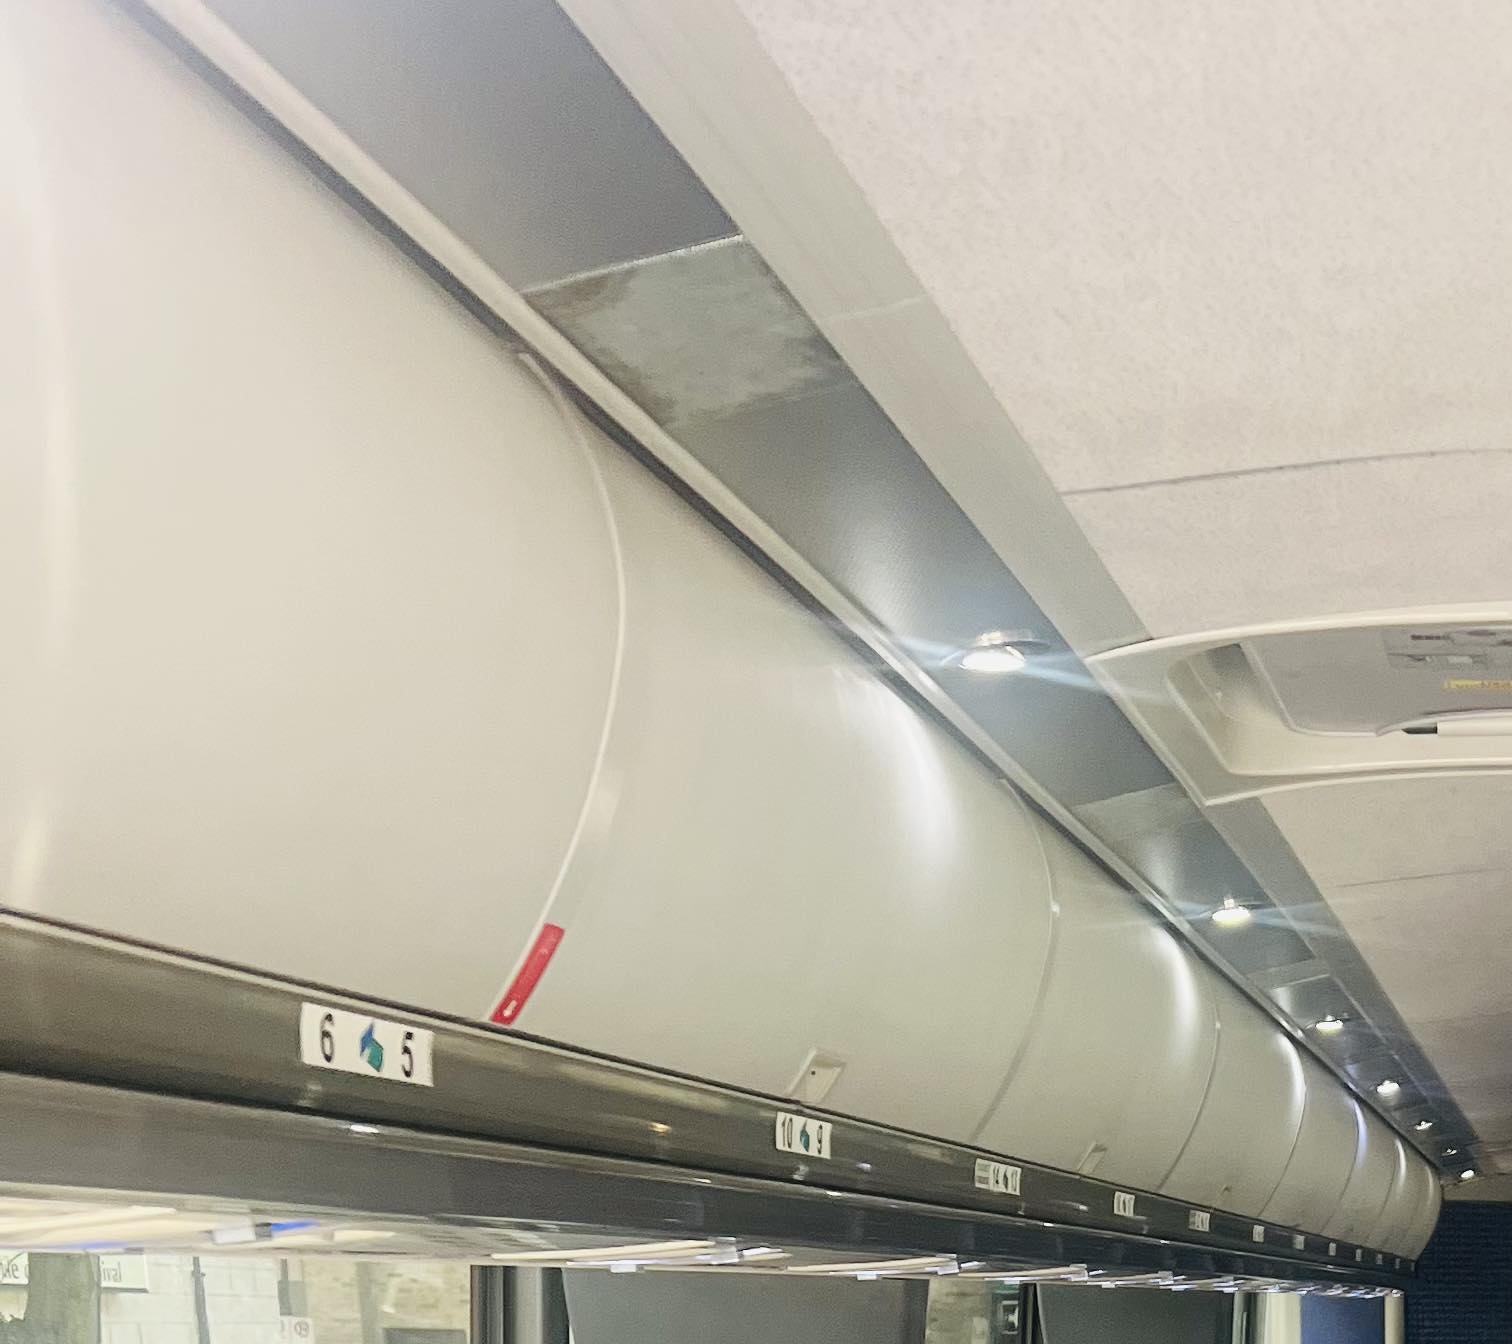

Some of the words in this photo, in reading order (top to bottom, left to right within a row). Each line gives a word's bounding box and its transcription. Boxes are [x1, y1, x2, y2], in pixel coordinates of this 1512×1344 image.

[320, 1012, 335, 1063] 6
[401, 1030, 414, 1078] 5
[782, 1116, 793, 1149] 10
[817, 1124, 823, 1155] 9
